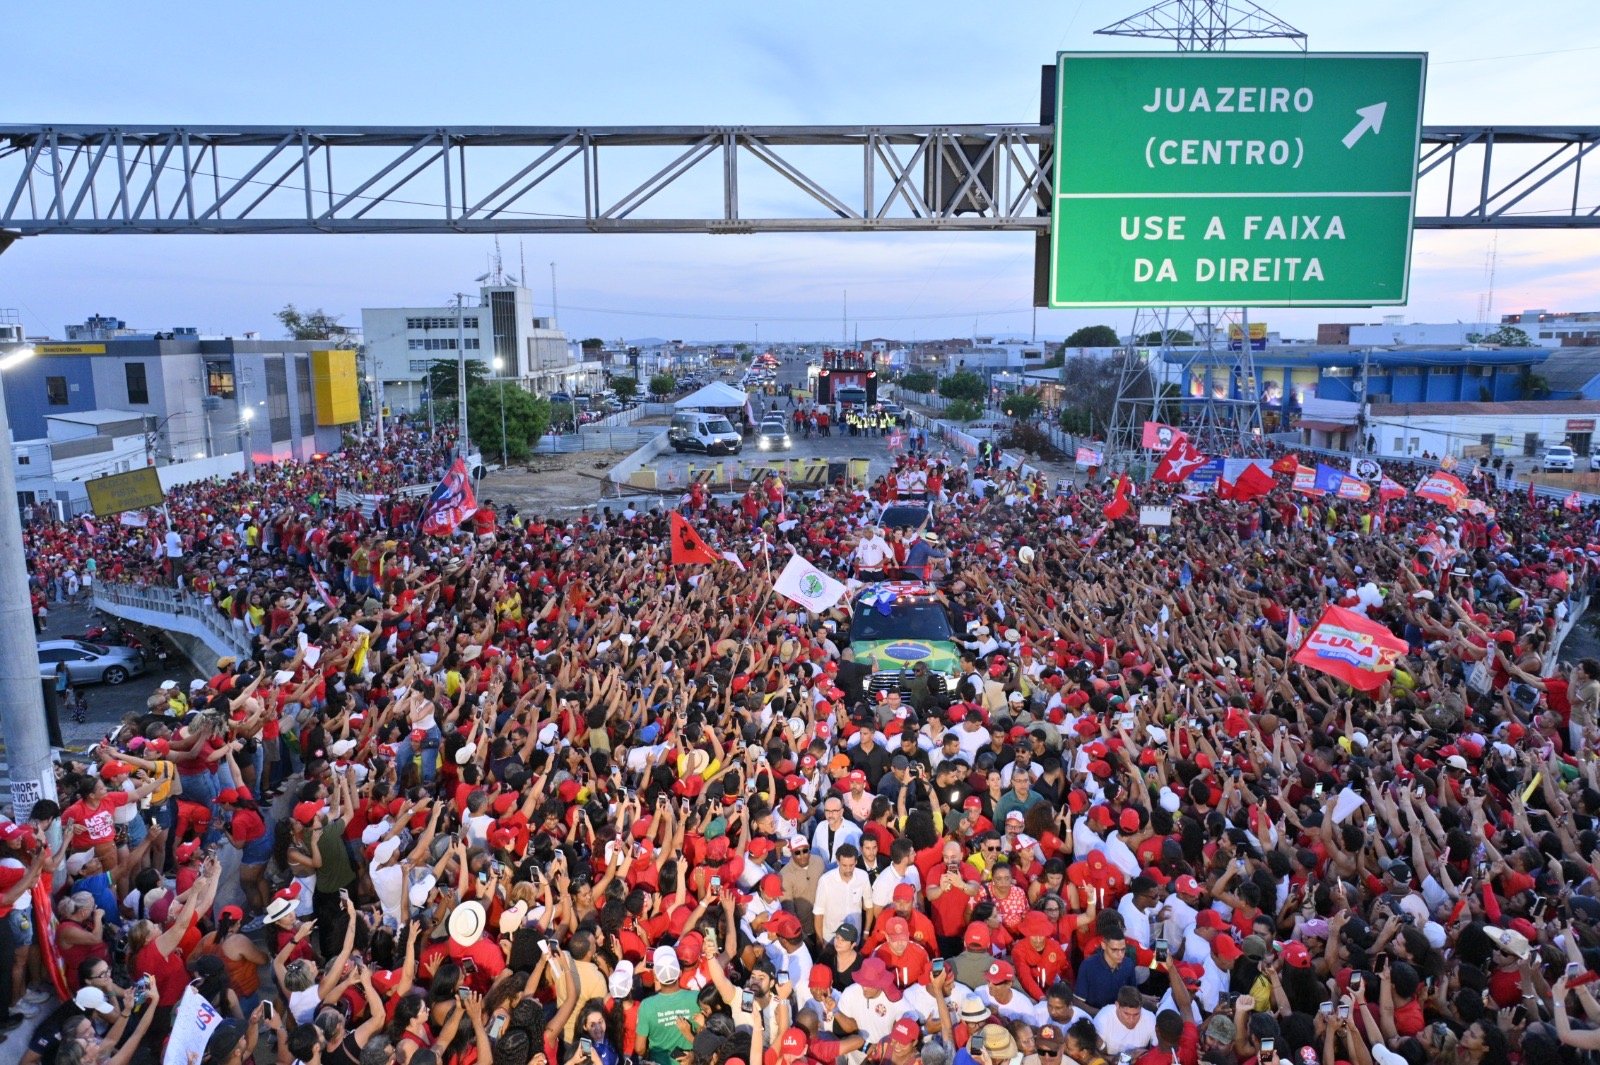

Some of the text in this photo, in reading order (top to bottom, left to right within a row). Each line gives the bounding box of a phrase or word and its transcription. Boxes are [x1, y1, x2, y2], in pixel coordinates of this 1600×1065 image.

[1143, 87, 1314, 112] JUAZEIRO
[1145, 137, 1304, 168] (CENTRO)
[1120, 215, 1346, 240] USE A FAIXA
[1134, 257, 1325, 282] DA DIREITA
[1311, 634, 1373, 658] LULA
[17, 791, 40, 803] VOLTA
[783, 1035, 798, 1046] LULA
